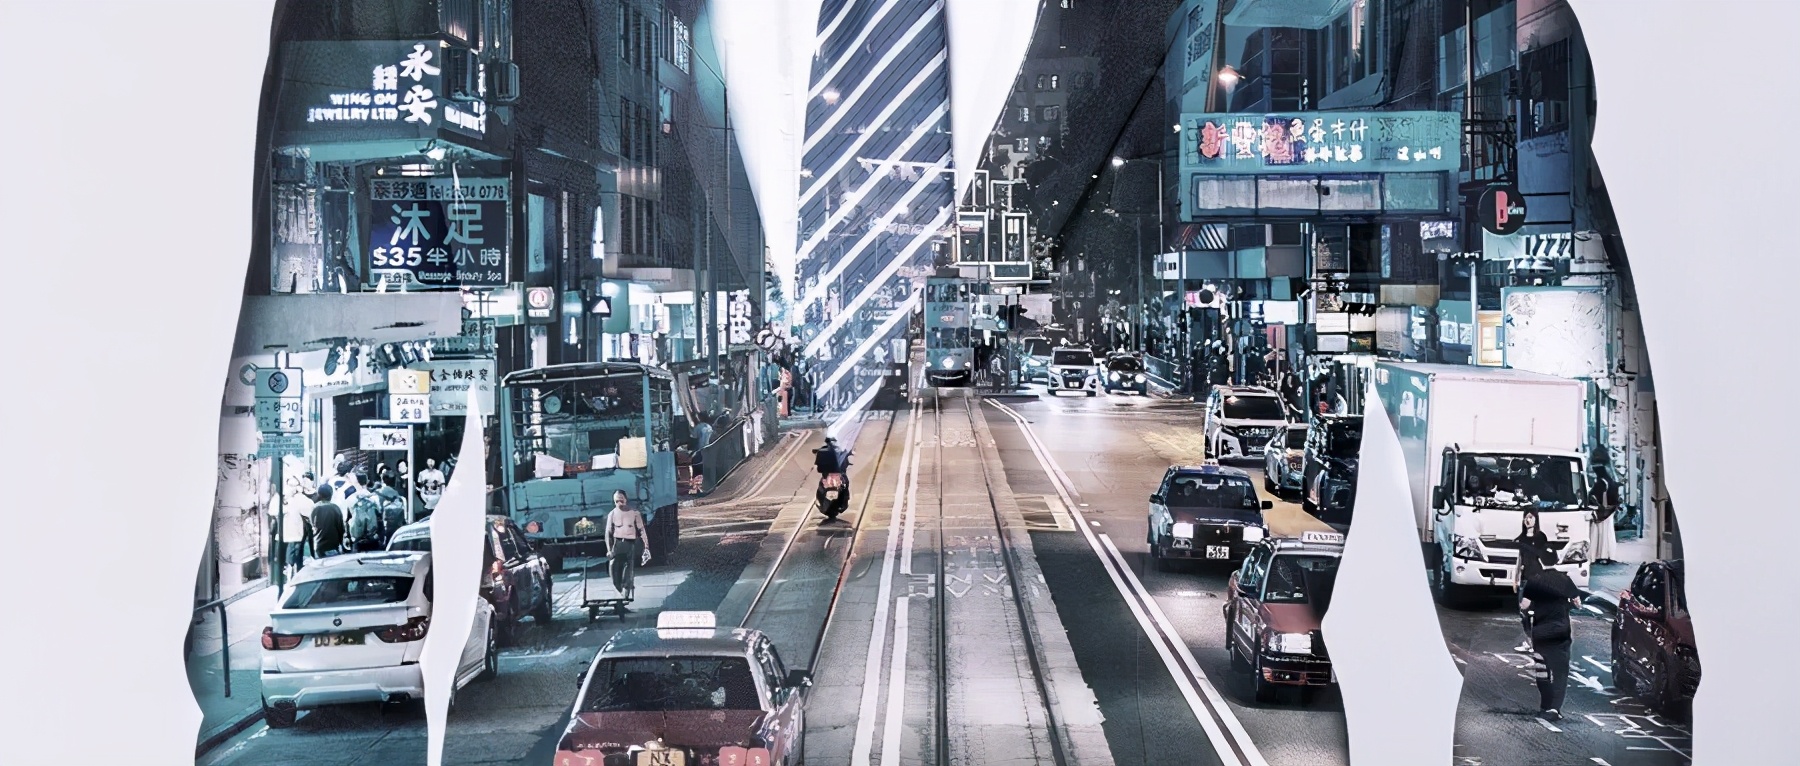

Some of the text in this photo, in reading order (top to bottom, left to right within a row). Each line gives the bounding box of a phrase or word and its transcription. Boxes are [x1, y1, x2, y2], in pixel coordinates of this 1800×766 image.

[399, 42, 441, 126] 永安
[329, 92, 398, 105] WING ON
[371, 107, 399, 121] LTD
[390, 202, 484, 246] 沐足
[373, 246, 502, 267] $35 半小時
